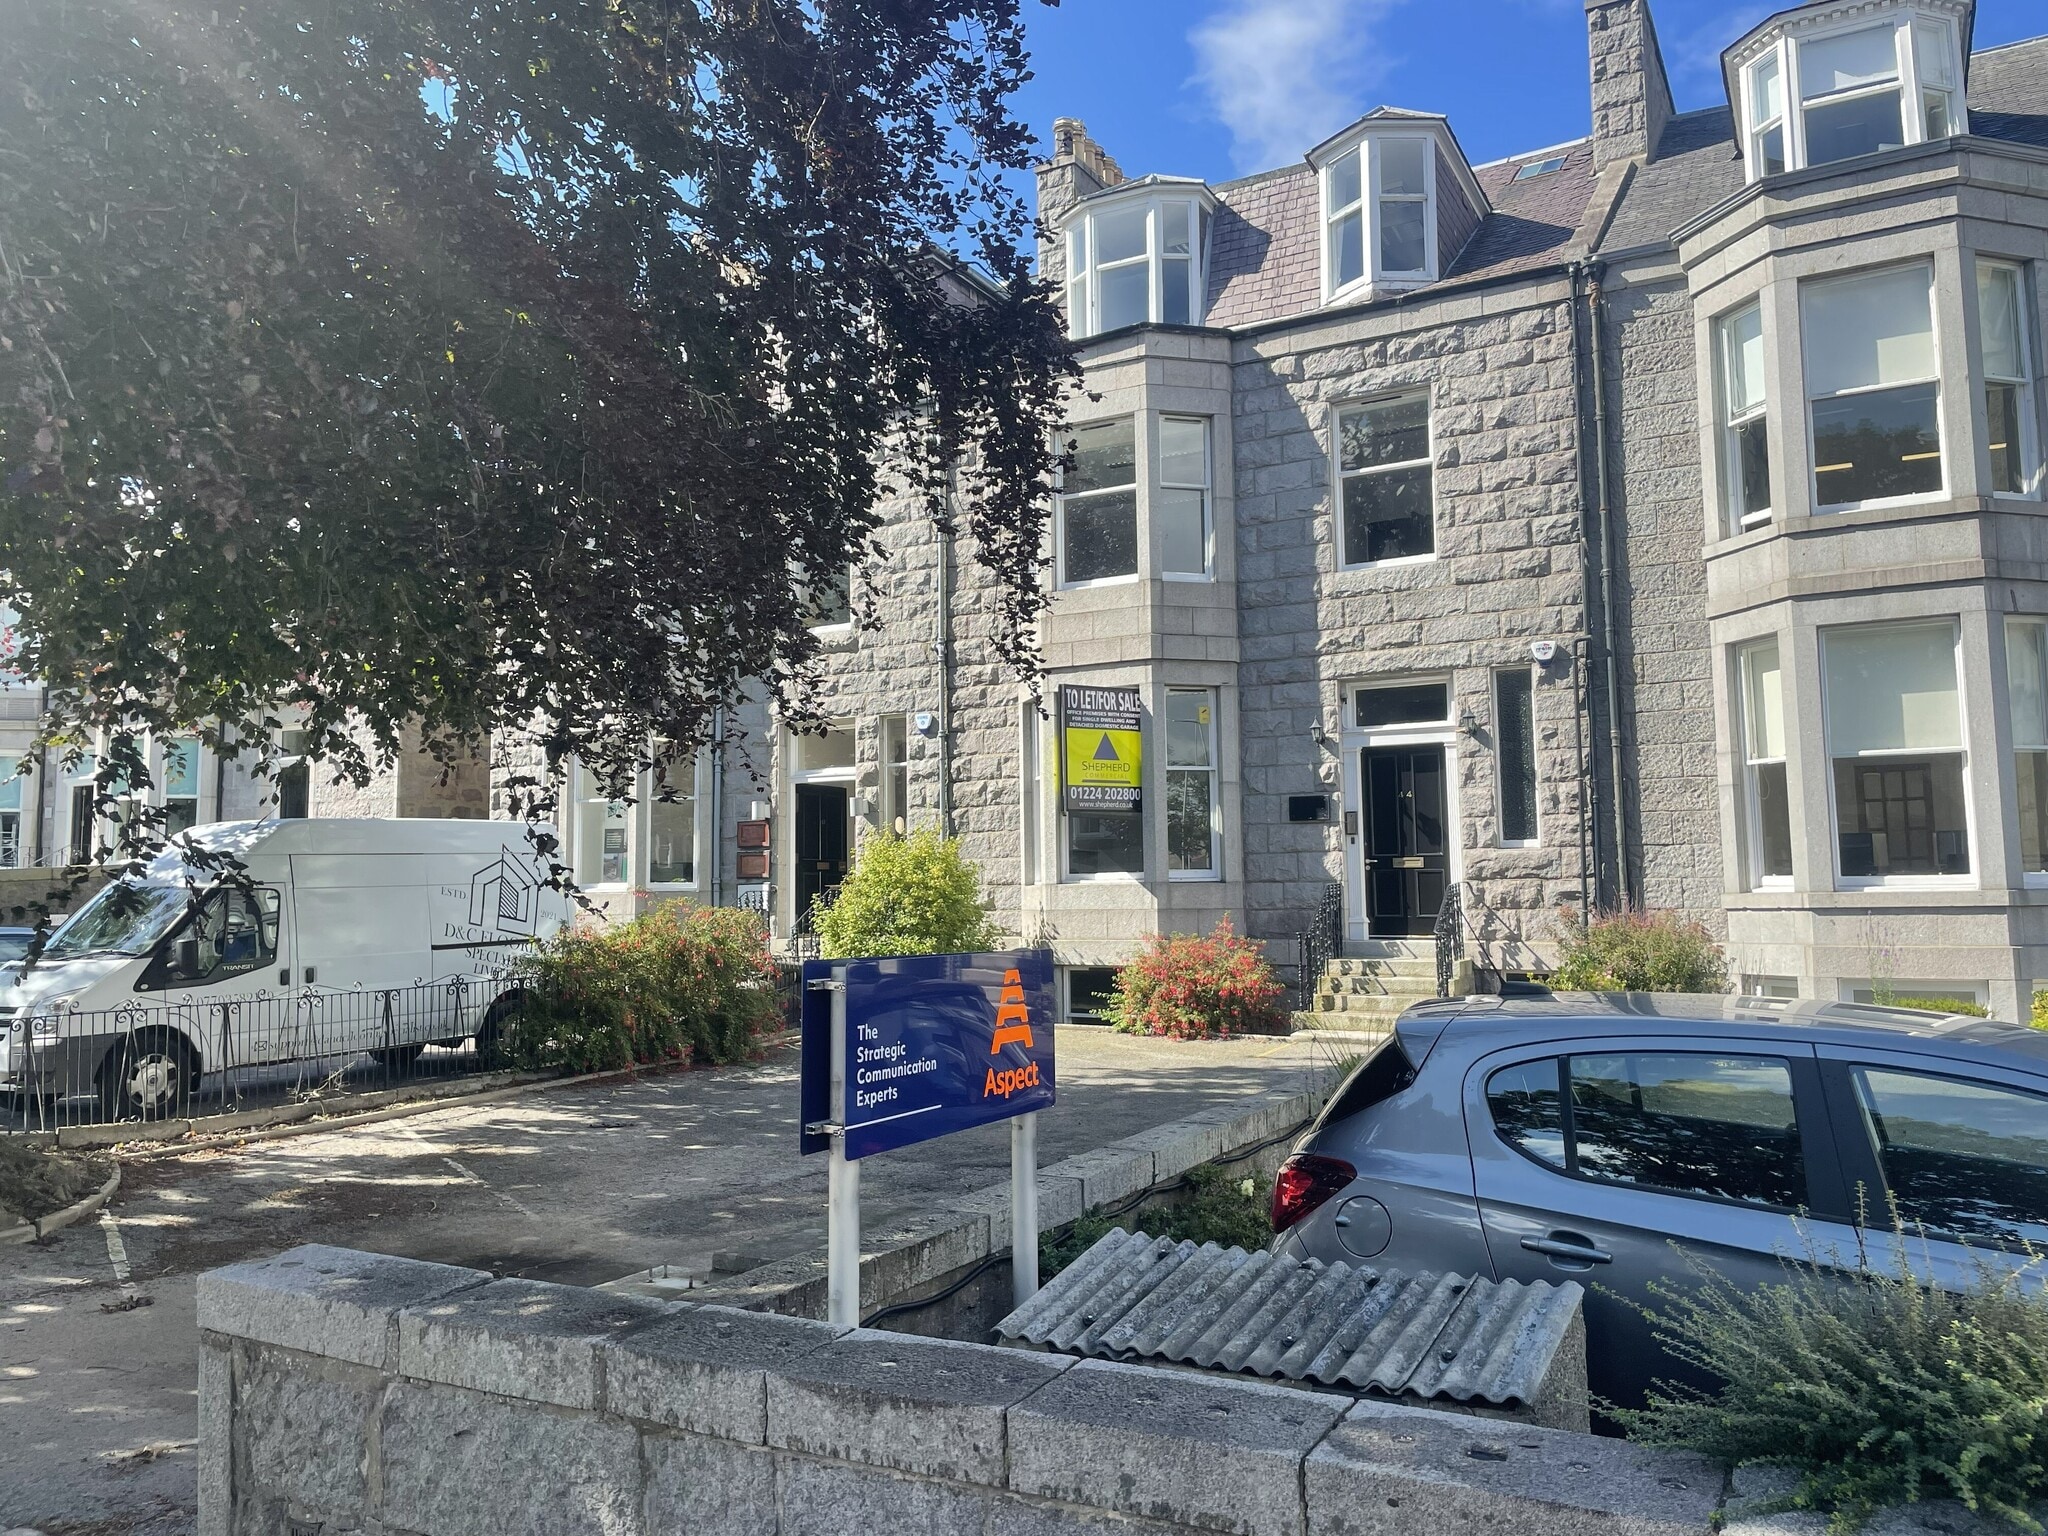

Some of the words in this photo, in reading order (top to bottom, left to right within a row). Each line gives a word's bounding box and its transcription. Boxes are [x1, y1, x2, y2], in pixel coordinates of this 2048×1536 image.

[1066, 688, 1078, 709] TO
[1080, 689, 1117, 711] LET/FOR
[1118, 692, 1141, 712] SALE
[1081, 760, 1131, 772] SHEPHERD
[1070, 786, 1102, 800] 01224
[1104, 787, 1141, 801] 202800
[1079, 801, 1134, 809] www.shepherd.co.uk
[540, 909, 557, 921] 2021
[444, 922, 477, 942] D&C
[222, 963, 254, 971] TRANSIT
[857, 1023, 878, 1041] The
[856, 1040, 906, 1063] Strategic
[856, 1056, 937, 1085] Communication
[983, 1060, 1040, 1099] Aspect
[856, 1086, 898, 1109] Experts
